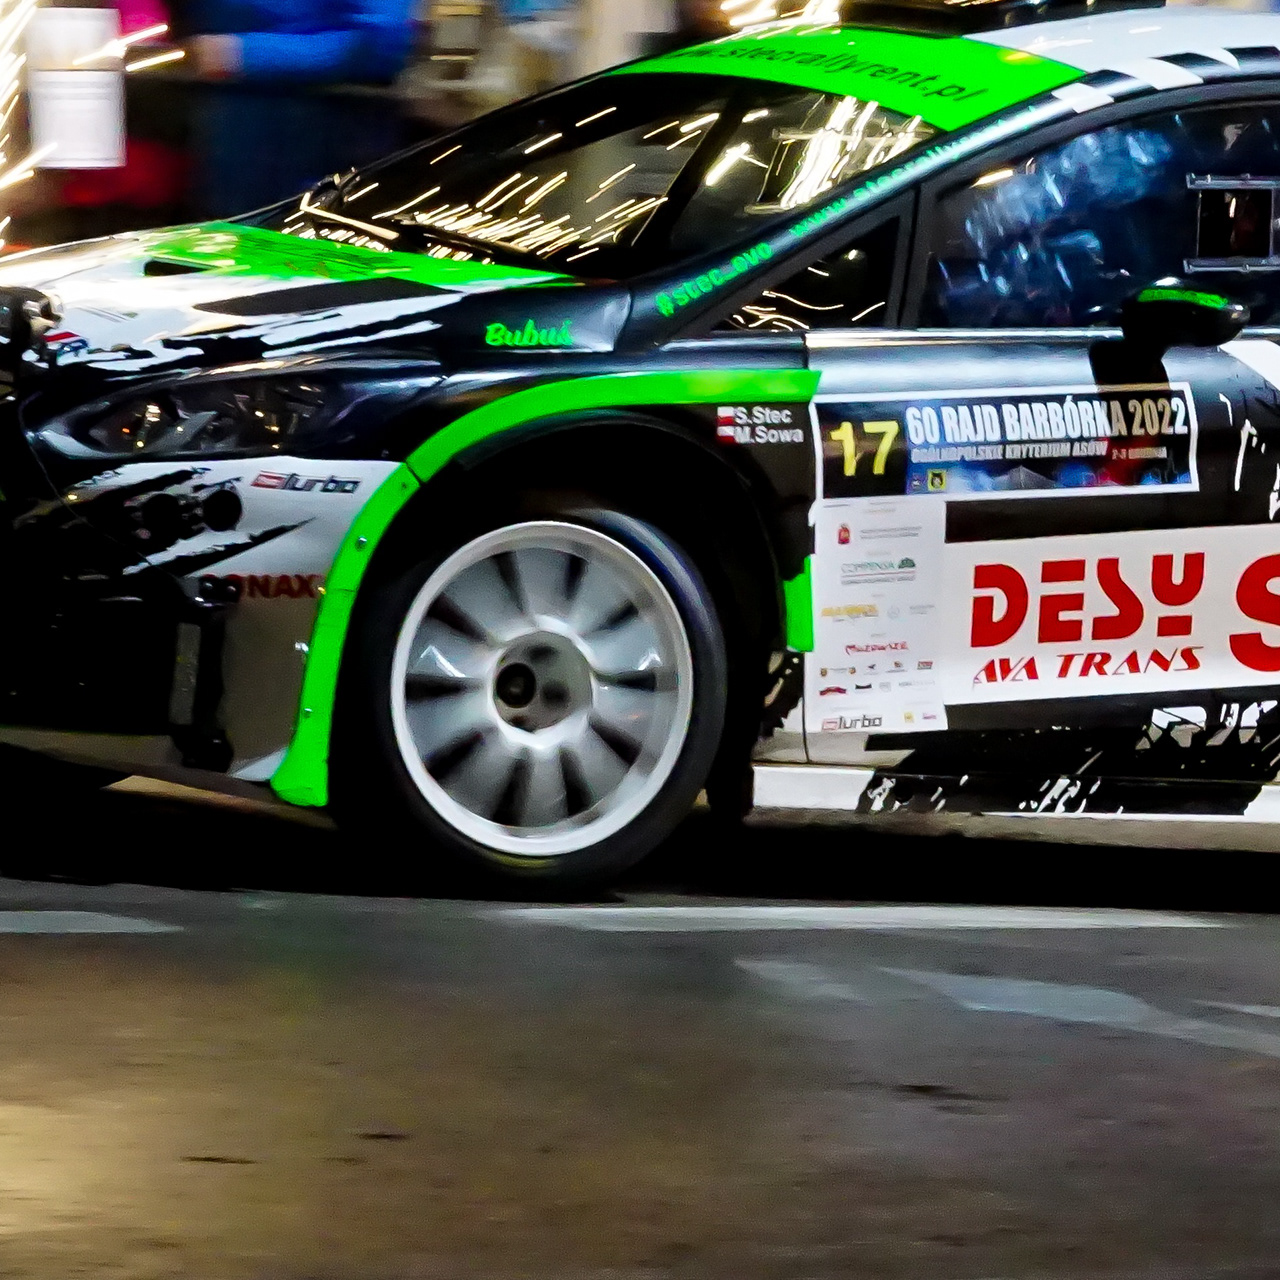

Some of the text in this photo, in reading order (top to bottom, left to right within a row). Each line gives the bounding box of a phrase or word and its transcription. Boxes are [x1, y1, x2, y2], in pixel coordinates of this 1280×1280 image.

[655, 242, 773, 318] #stec_evo
[733, 405, 793, 425] S.Stec
[733, 425, 804, 444] M.Sowa
[905, 395, 1188, 445] 60 RAJD BARBÓRKA 2022
[829, 420, 900, 477] 17
[199, 574, 322, 600] NAX
[970, 551, 1206, 650] DESU
[972, 644, 1206, 686] AVA TRANS
